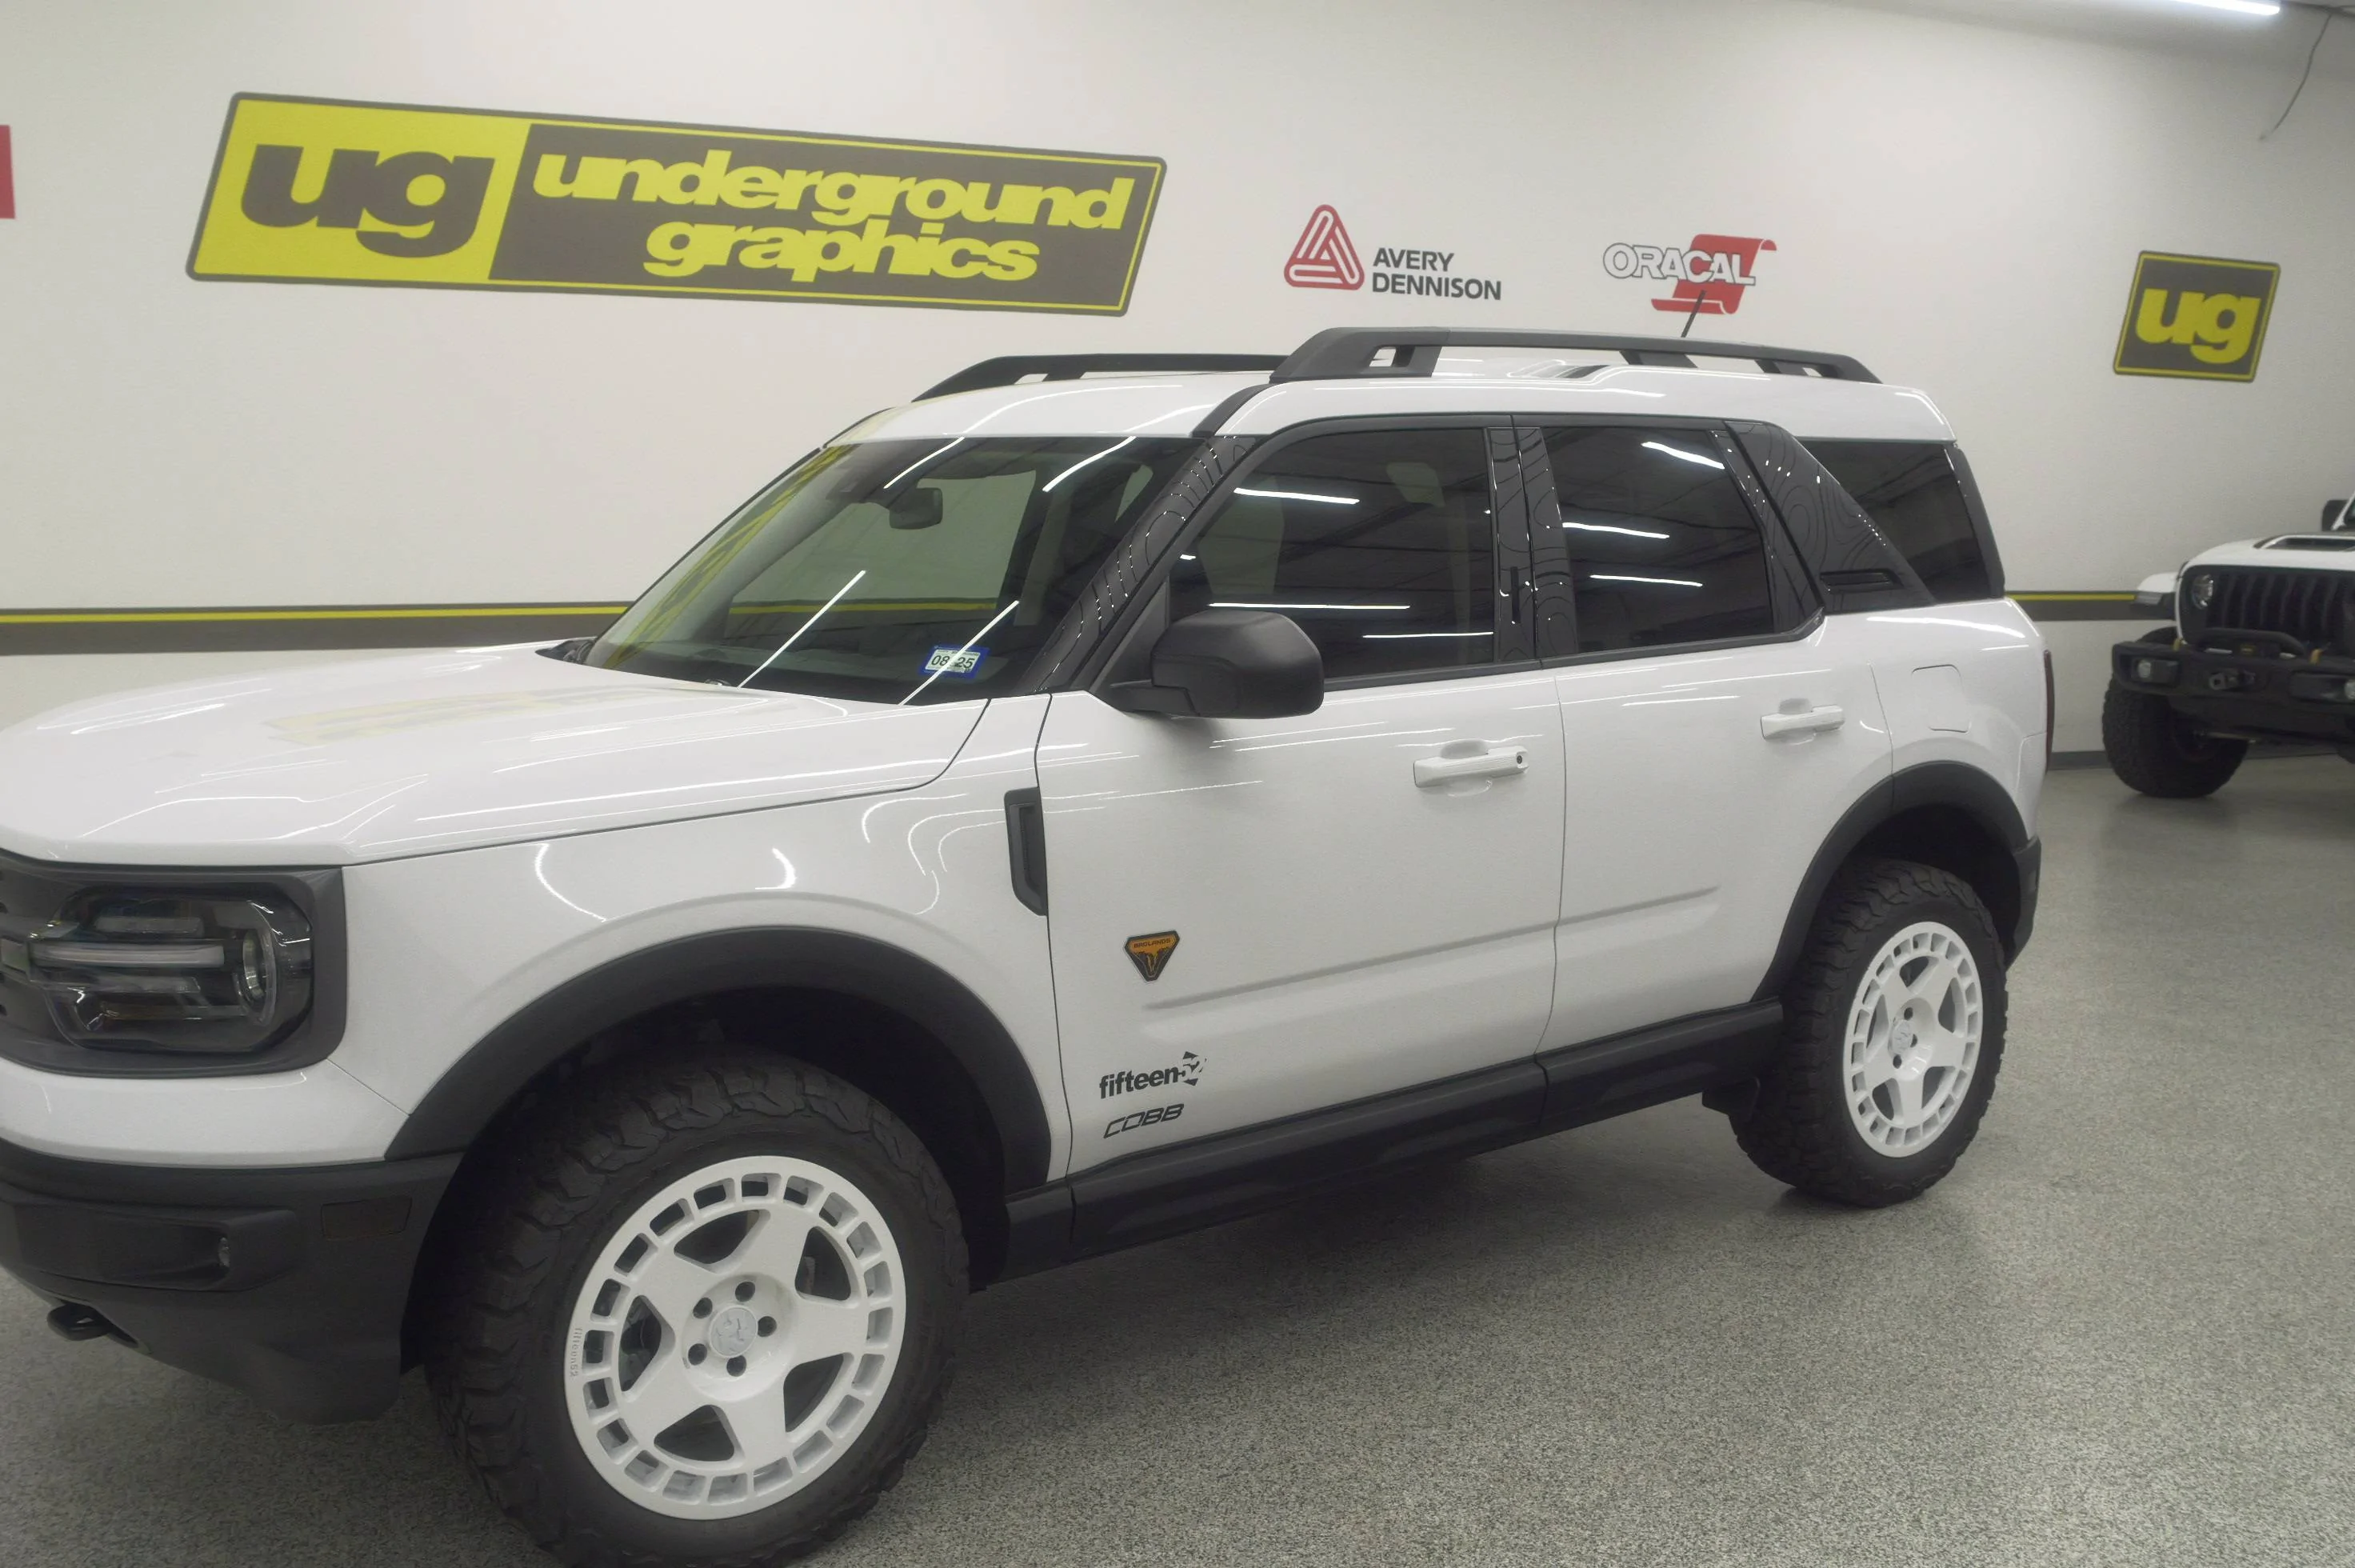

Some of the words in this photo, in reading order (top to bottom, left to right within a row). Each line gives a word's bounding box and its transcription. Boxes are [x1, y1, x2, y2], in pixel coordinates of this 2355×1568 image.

[241, 144, 495, 258] ug
[533, 150, 1135, 230] underground
[643, 219, 1040, 282] graphics
[1373, 247, 1454, 271] AVERY
[1602, 242, 1756, 286] ORACAL
[1372, 272, 1501, 300] DENNISON
[2135, 288, 2261, 364] ug
[931, 655, 950, 666] 08
[954, 657, 975, 669] 25
[1134, 938, 1171, 948] BADLANDS
[1103, 1103, 1184, 1138] COBB
